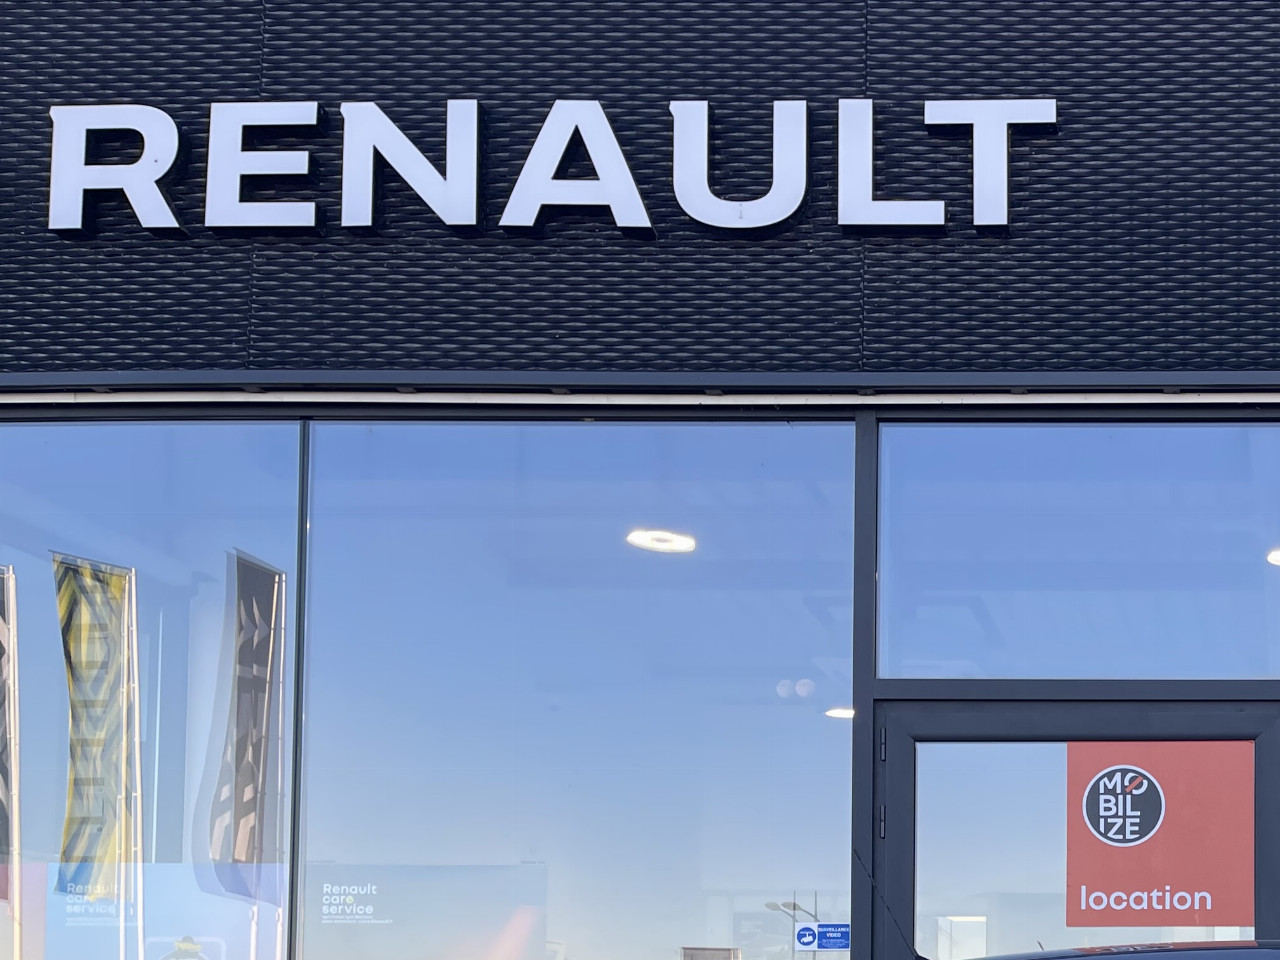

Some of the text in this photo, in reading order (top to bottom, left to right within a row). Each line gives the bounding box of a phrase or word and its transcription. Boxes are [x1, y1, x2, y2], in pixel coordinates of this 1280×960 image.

[48, 98, 1057, 230] RENAULT
[67, 883, 120, 894] Renault
[323, 883, 377, 894] Renault
[322, 895, 354, 904] care
[1080, 885, 1212, 910] location
[66, 904, 116, 914] service
[322, 904, 374, 914] service
